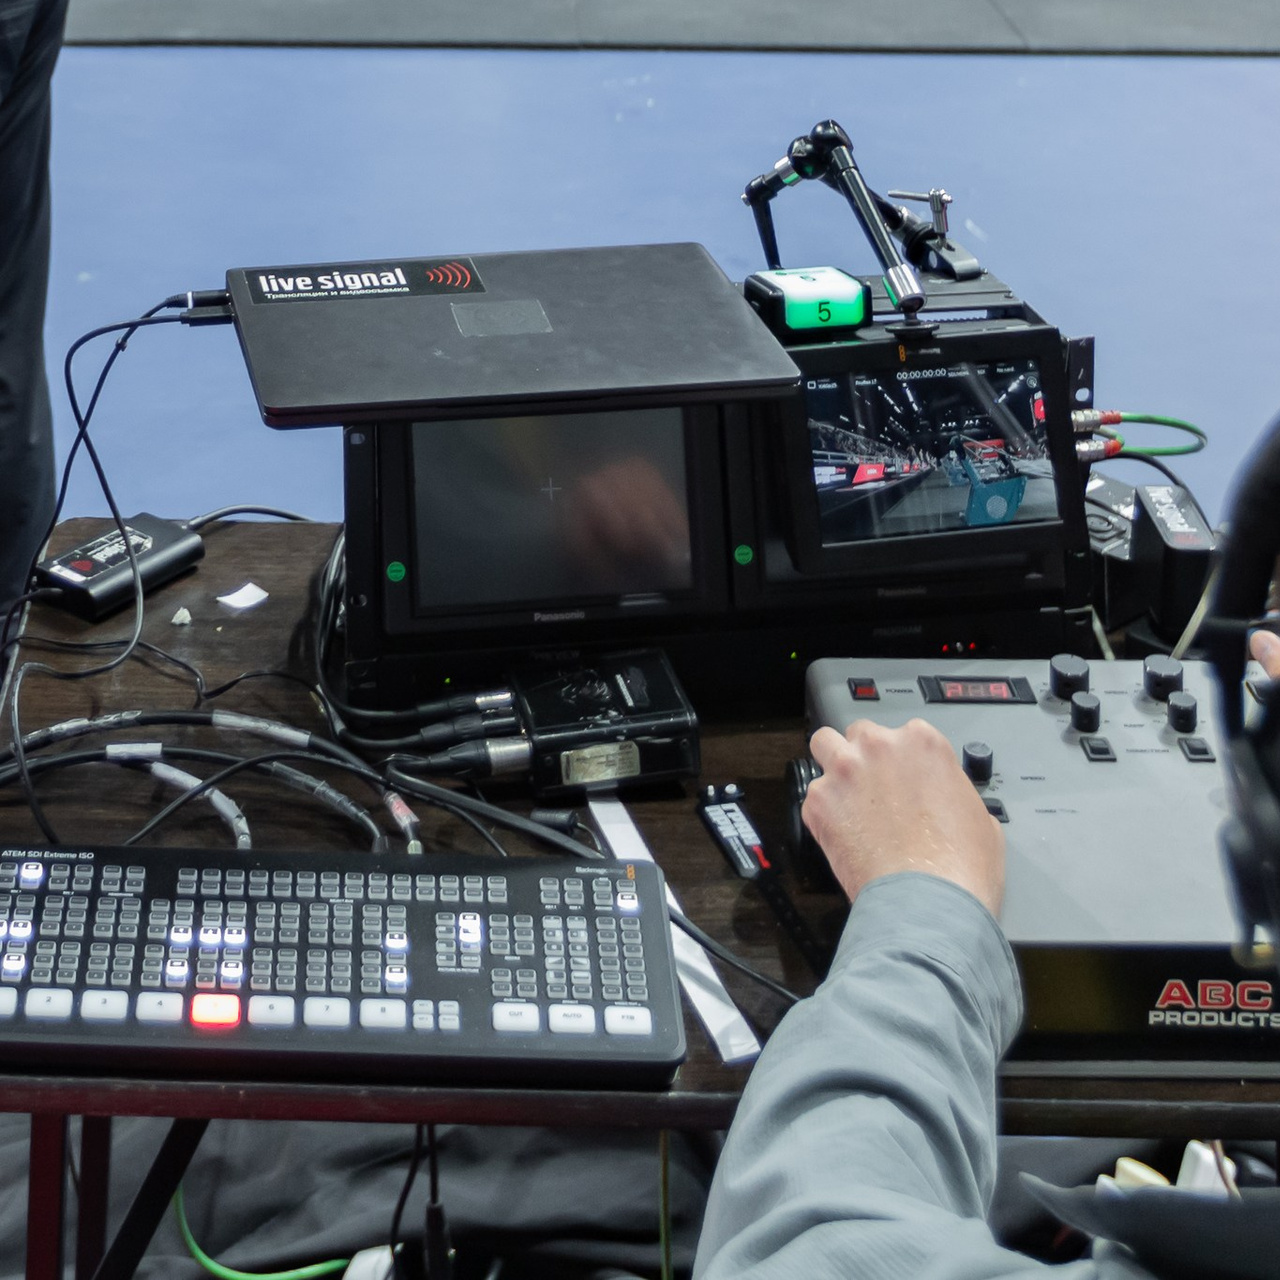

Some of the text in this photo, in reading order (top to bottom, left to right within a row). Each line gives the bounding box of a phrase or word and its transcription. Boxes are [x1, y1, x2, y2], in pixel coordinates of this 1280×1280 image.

[258, 268, 408, 293] live signal
[818, 301, 832, 323] 5
[896, 368, 947, 381] 00:00:00:00
[534, 609, 586, 622] Panasonic
[27, 850, 43, 858] SDI
[43, 851, 78, 859] Extreme
[1155, 979, 1272, 1010] ABC
[1149, 1010, 1280, 1028] PRODUCTS
